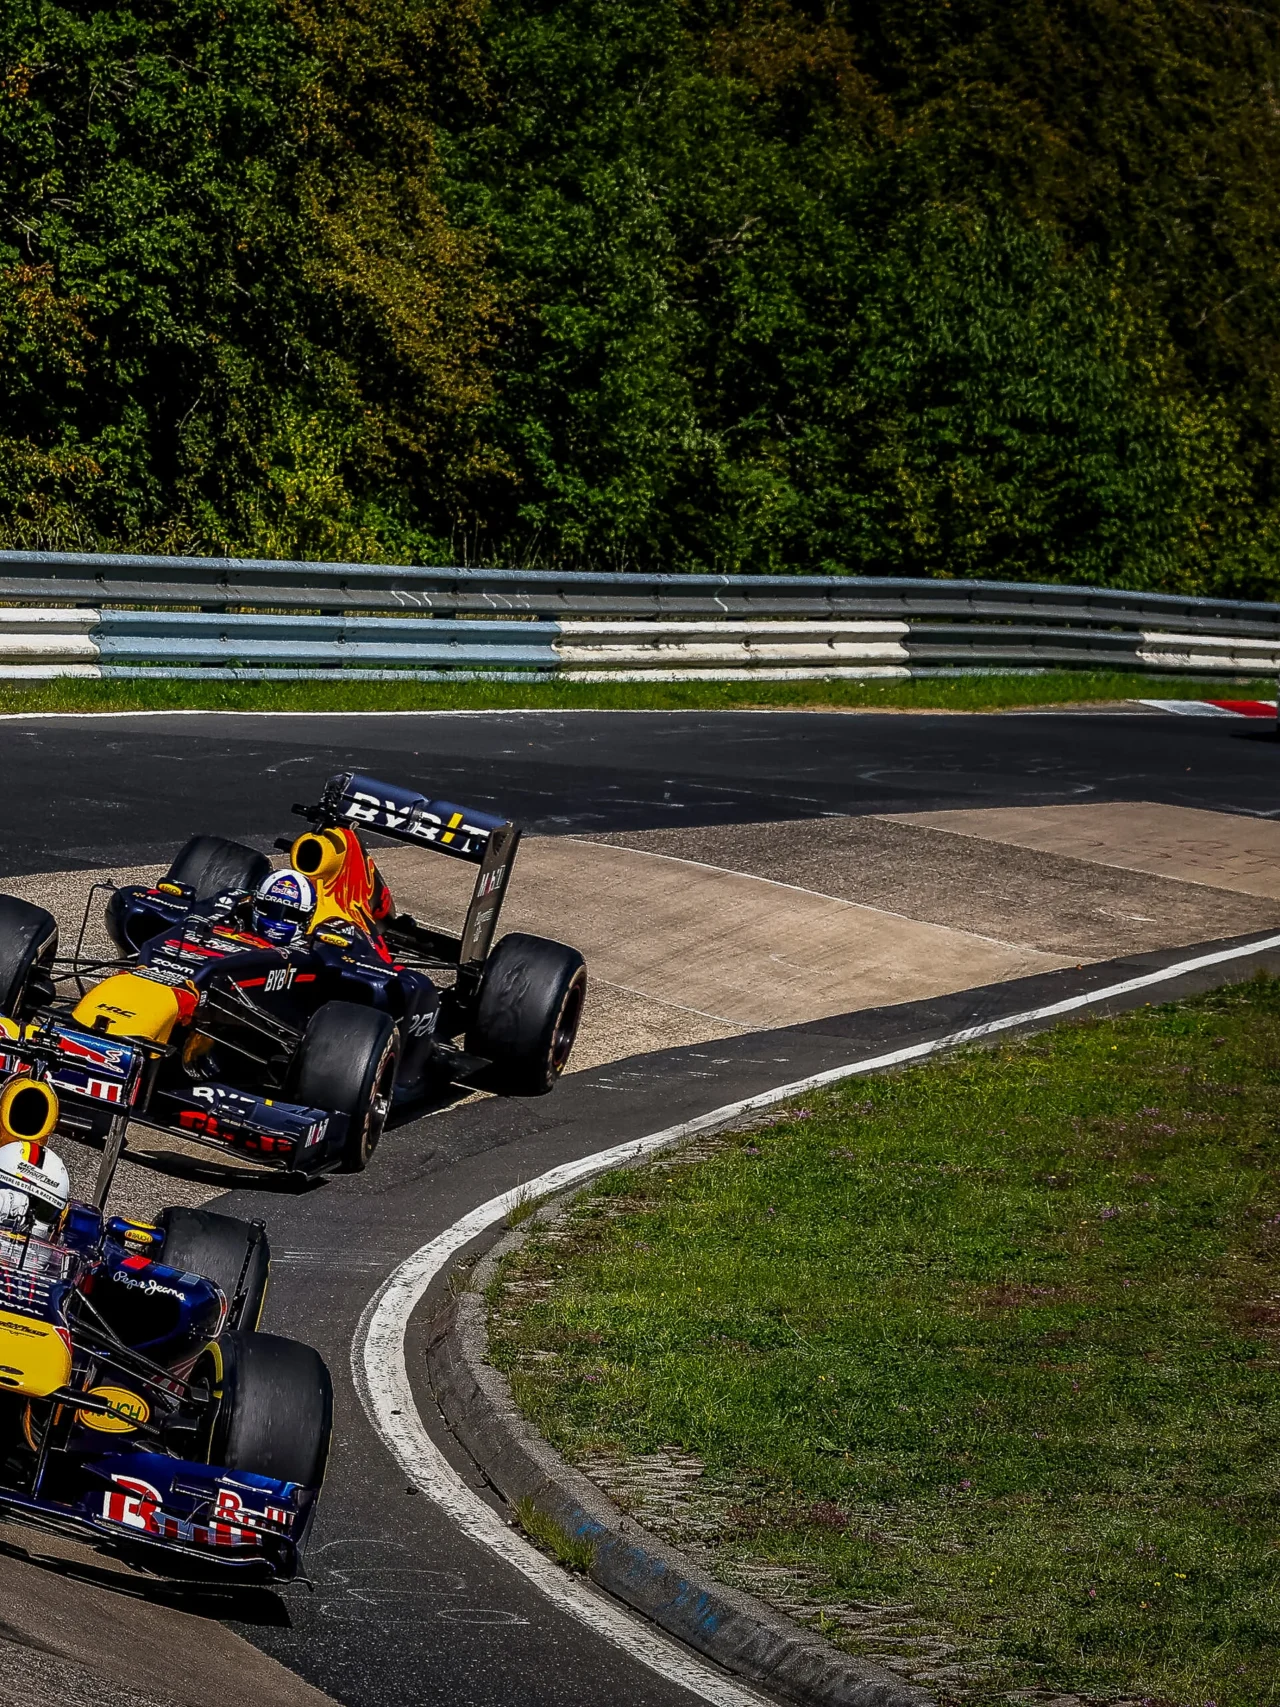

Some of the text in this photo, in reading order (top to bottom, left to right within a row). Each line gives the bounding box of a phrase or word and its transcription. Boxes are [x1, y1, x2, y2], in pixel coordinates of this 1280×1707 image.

[265, 893, 299, 909] ORACLE
[264, 963, 297, 993] BYBIT
[97, 1002, 136, 1019] HRC
[0, 1174, 15, 1185] THERE
[20, 1182, 35, 1193] STILL
[39, 1190, 52, 1200] RACE
[131, 1231, 151, 1242] RAUCH
[113, 1270, 186, 1301] Pepe Jeans
